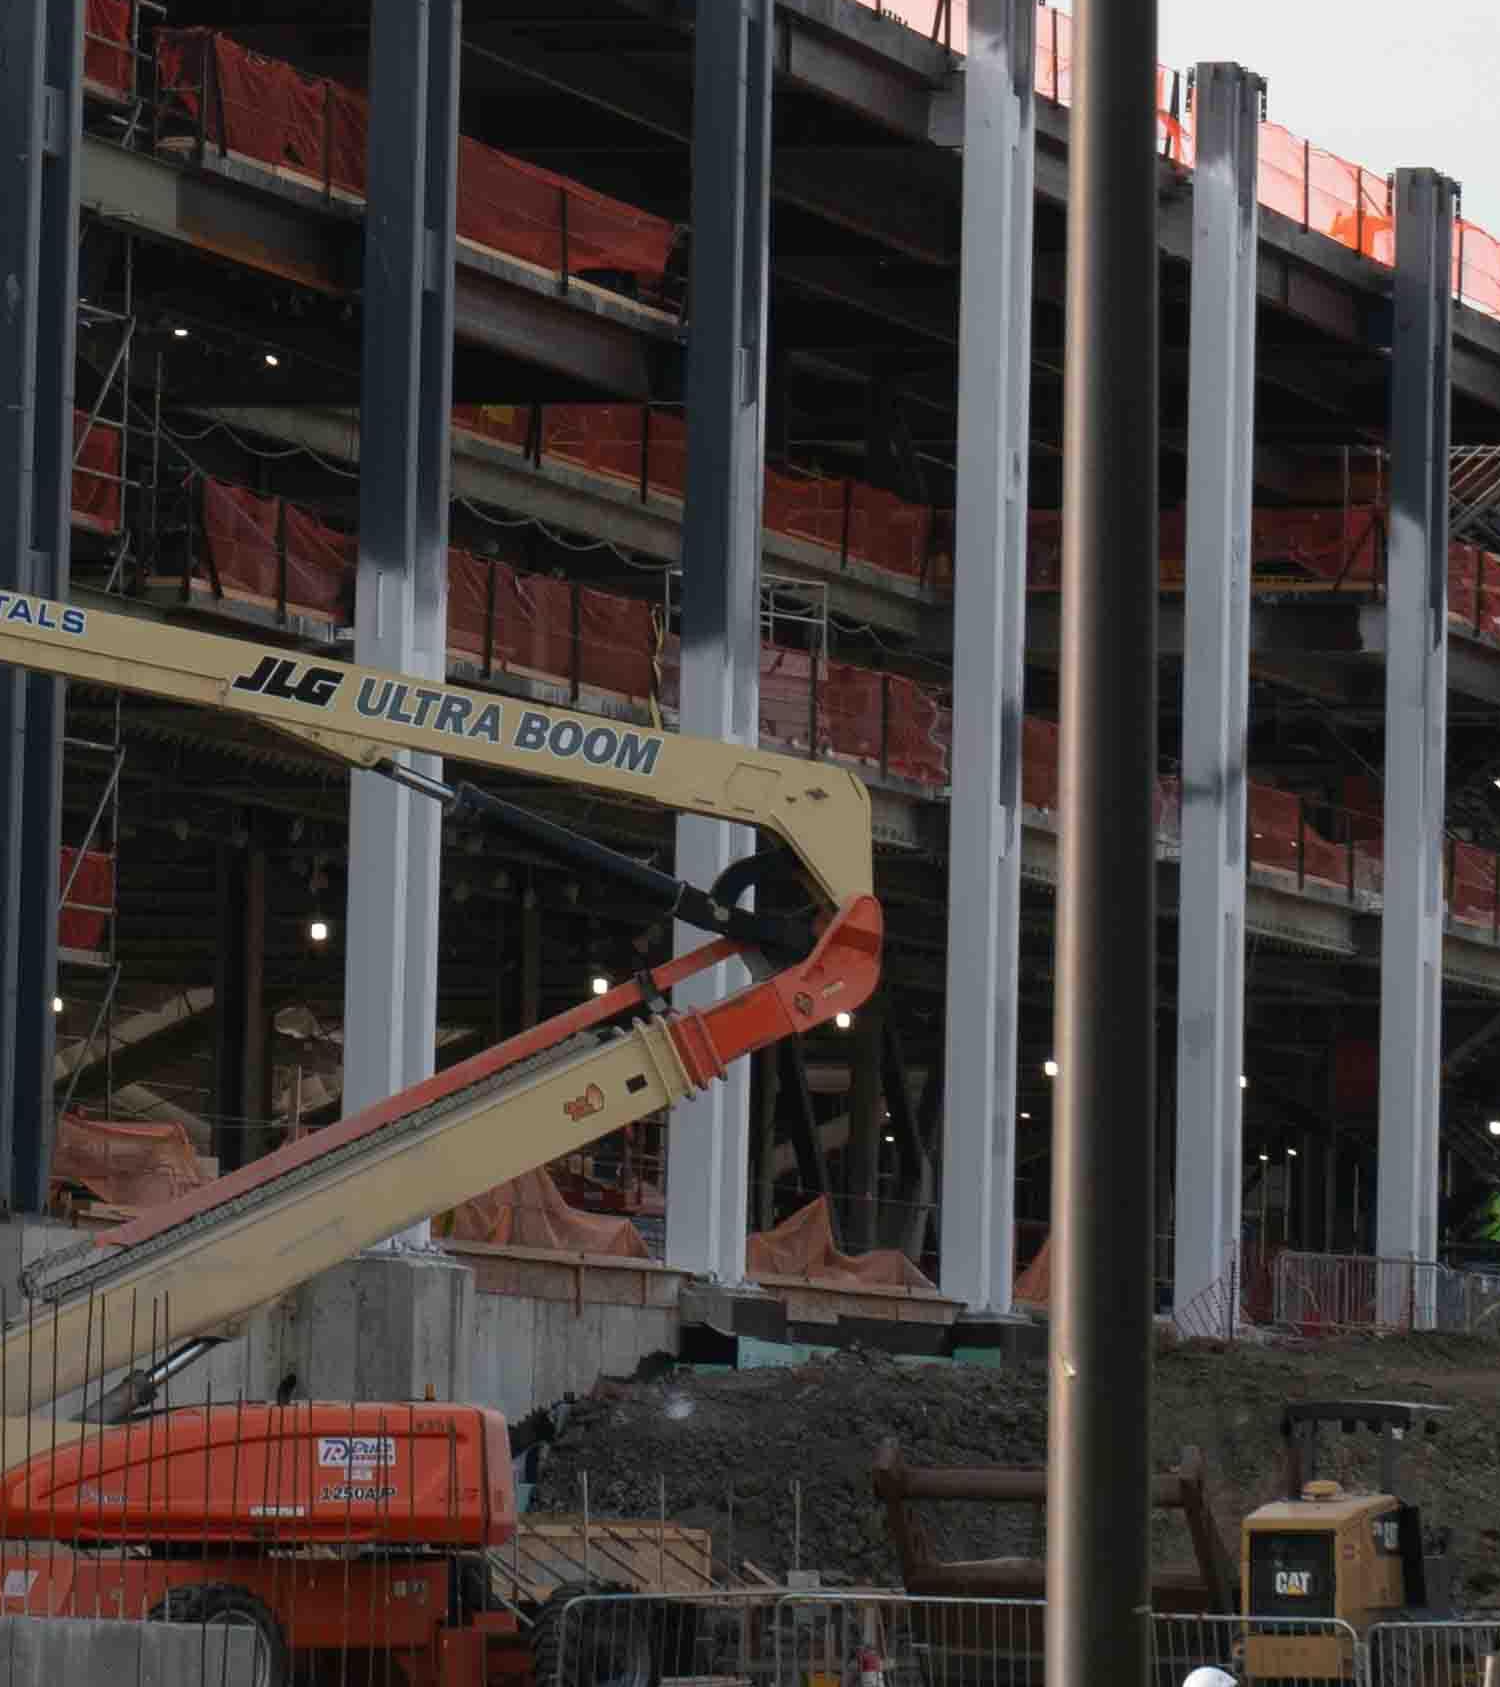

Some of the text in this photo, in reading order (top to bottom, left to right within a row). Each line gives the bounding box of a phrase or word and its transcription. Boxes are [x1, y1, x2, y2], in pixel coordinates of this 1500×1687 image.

[231, 655, 664, 776] JLG ULTRA BOOM
[1275, 1571, 1312, 1596] CAT
